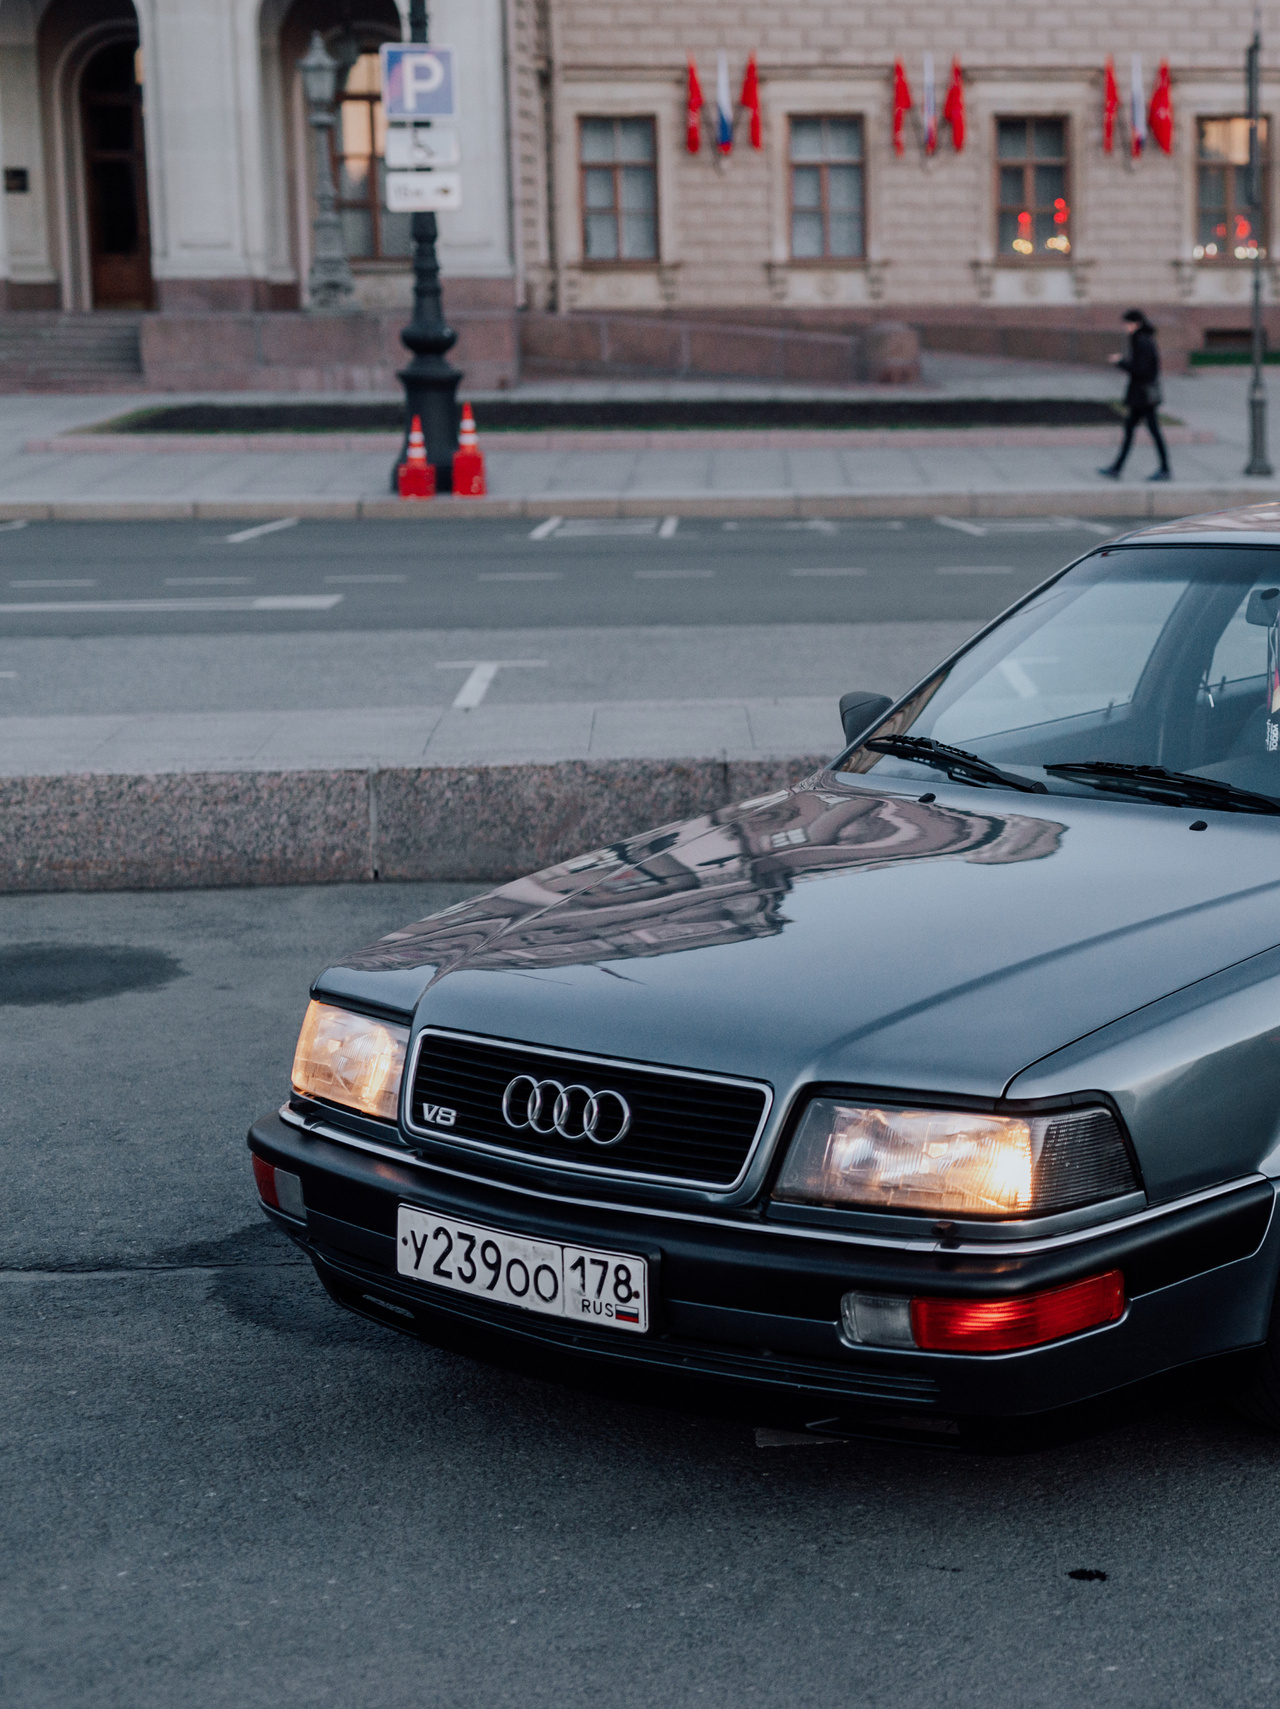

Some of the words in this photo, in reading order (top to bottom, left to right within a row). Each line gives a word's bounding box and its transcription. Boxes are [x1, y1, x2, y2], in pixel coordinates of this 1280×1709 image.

[402, 54, 444, 112] P
[422, 1103, 457, 1127] V8
[570, 1256, 633, 1303] 178
[581, 1299, 614, 1318] RUS
